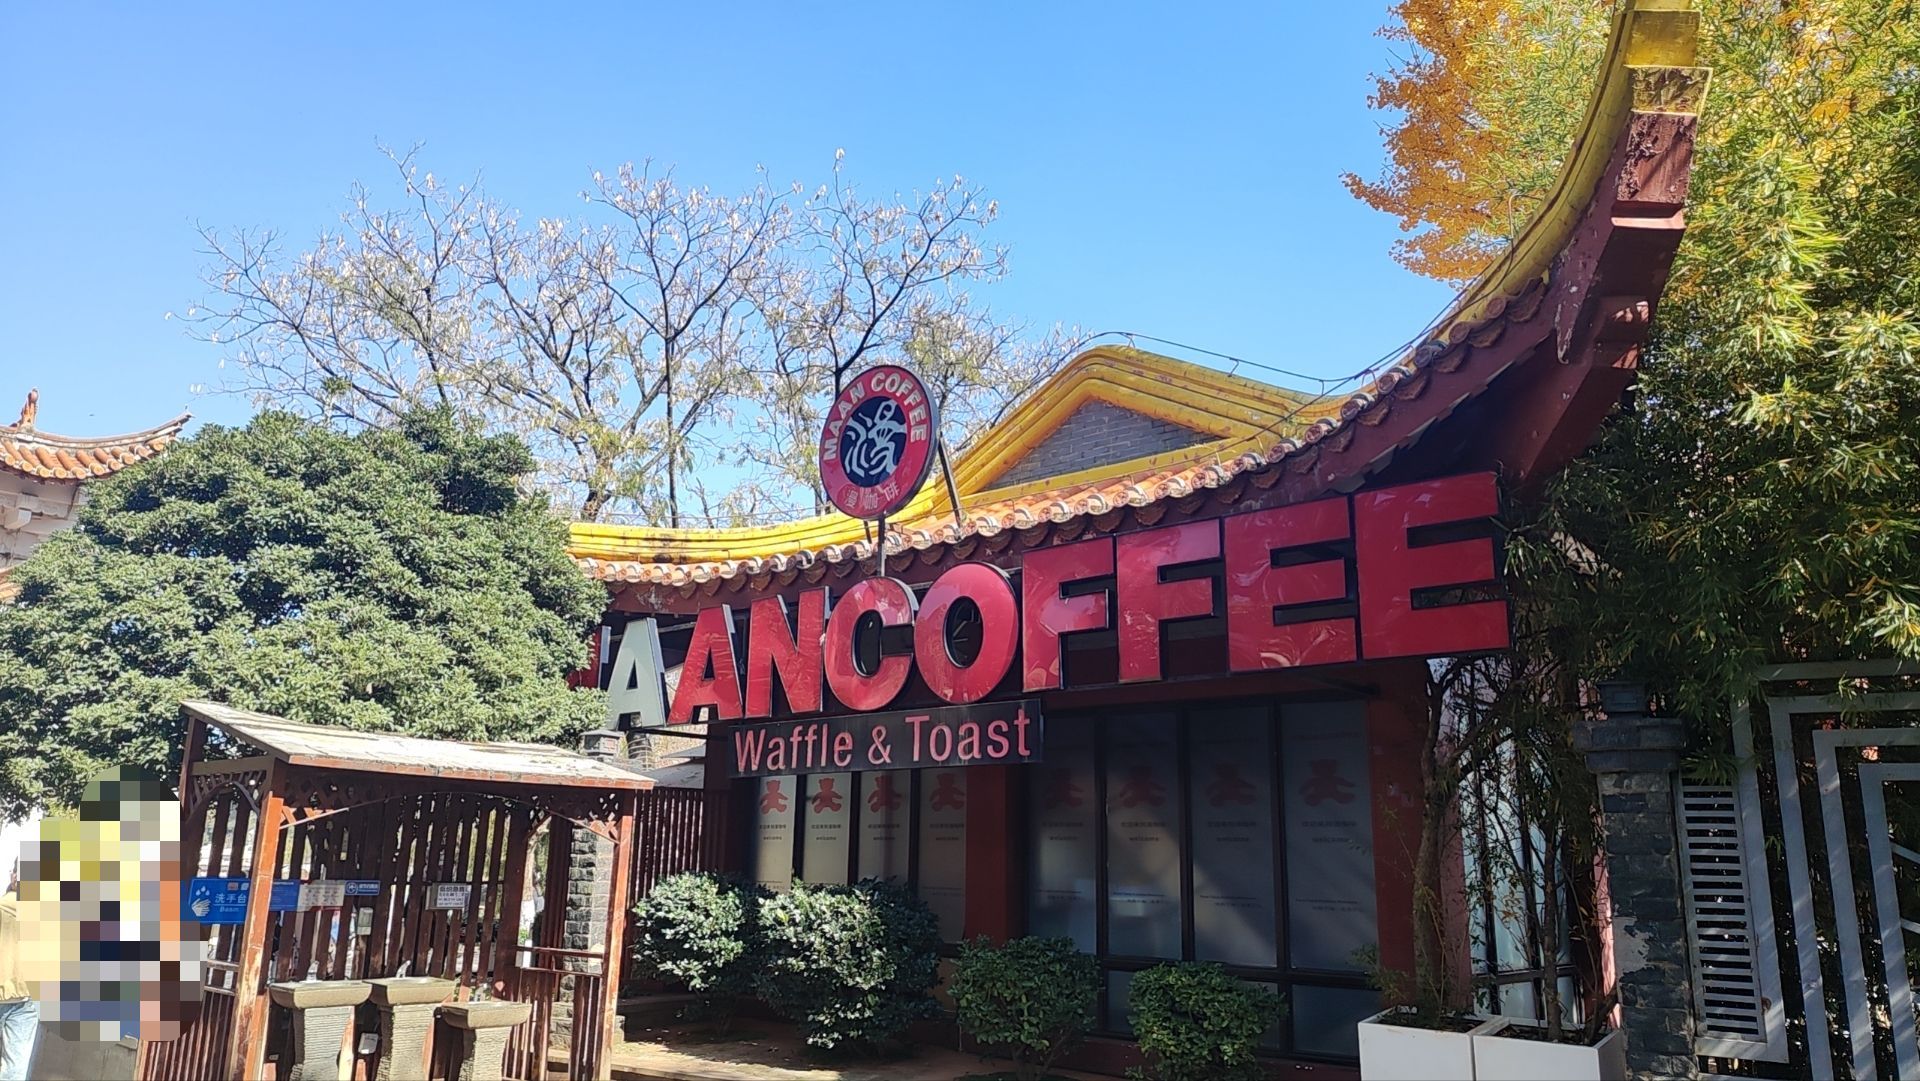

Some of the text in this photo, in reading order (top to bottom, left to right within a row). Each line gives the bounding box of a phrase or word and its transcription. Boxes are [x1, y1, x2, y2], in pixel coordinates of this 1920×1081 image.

[823, 372, 928, 461] MAAN COFFEE
[734, 709, 1031, 772] Waffle & Toast
[214, 892, 247, 904] 洗手台
